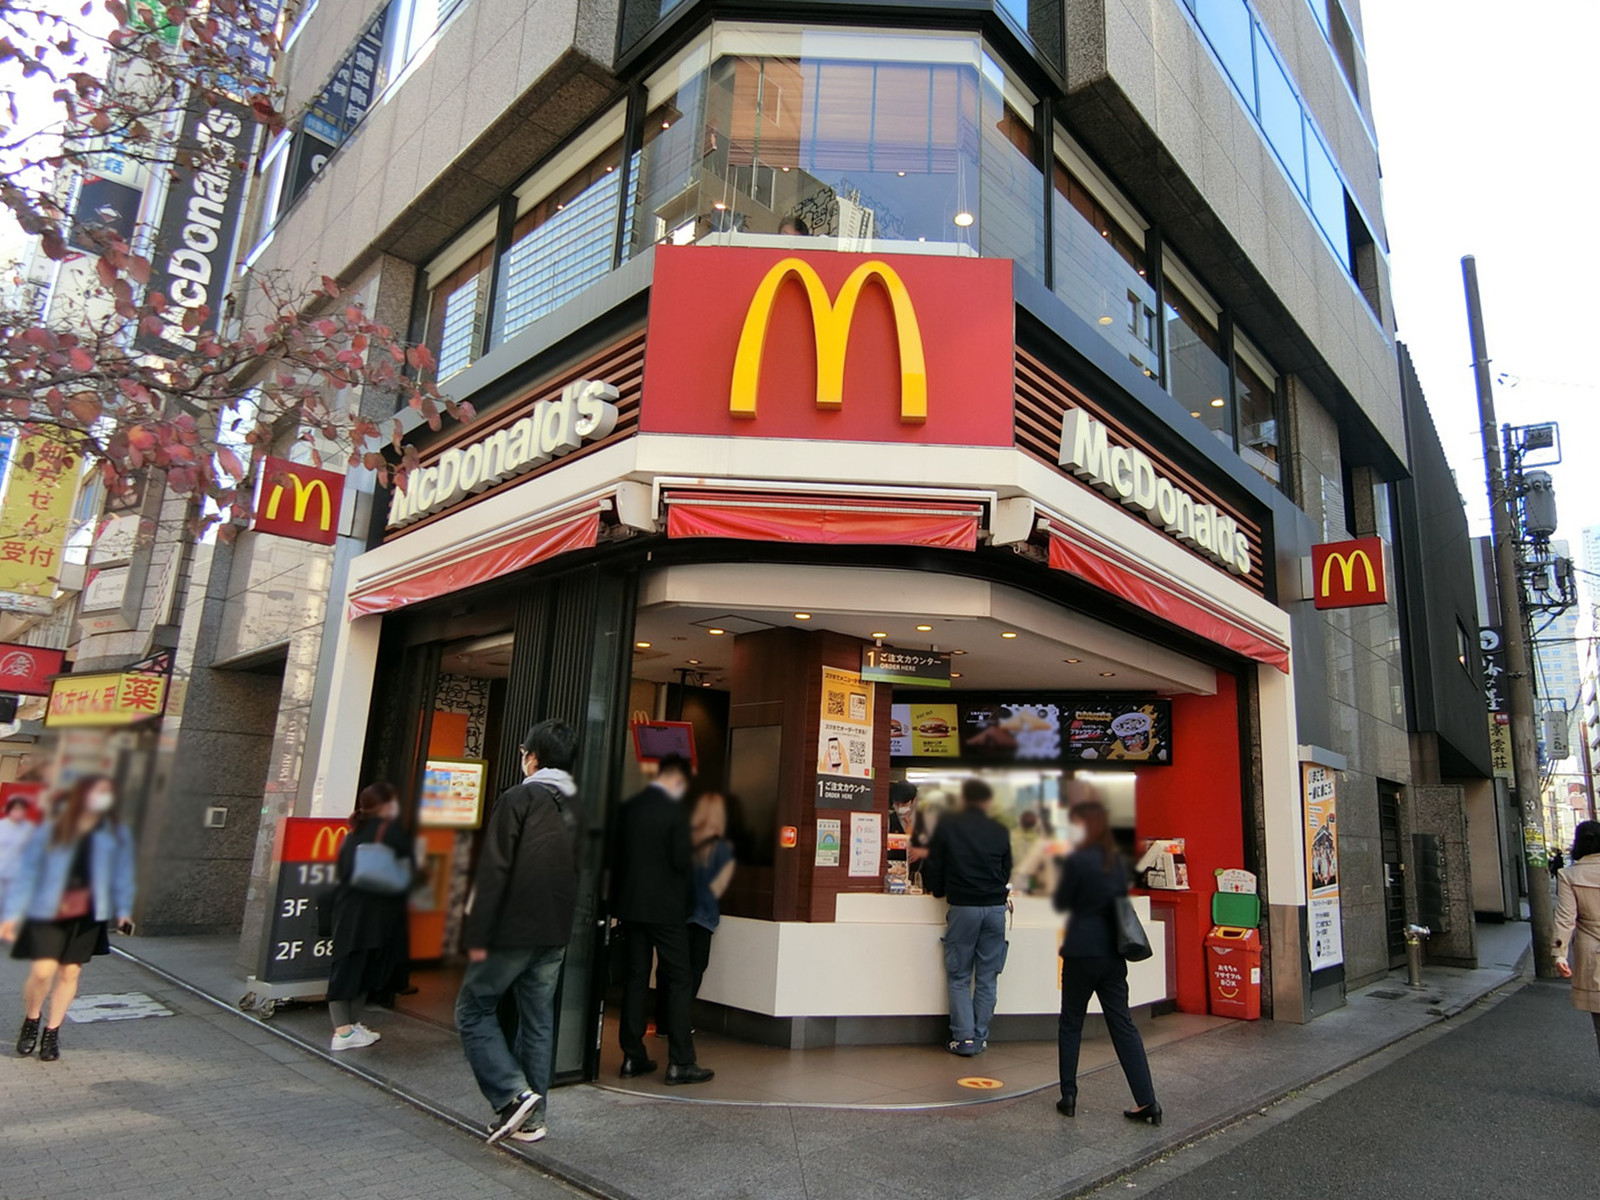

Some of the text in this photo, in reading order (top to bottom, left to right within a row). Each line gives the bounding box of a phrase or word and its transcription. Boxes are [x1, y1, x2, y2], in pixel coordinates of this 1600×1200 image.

[160, 108, 243, 352] McDonald's
[388, 379, 620, 529] McDonald's
[1059, 407, 1251, 575] McDonald's
[1, 541, 55, 567] 受付
[867, 651, 942, 668] 1 ご注文カウンター
[121, 677, 161, 710] 薬
[818, 780, 871, 797] 1 ご注文カウンター
[281, 898, 309, 918] 3F
[275, 941, 304, 961] 2F
[1220, 979, 1237, 987] BOX
